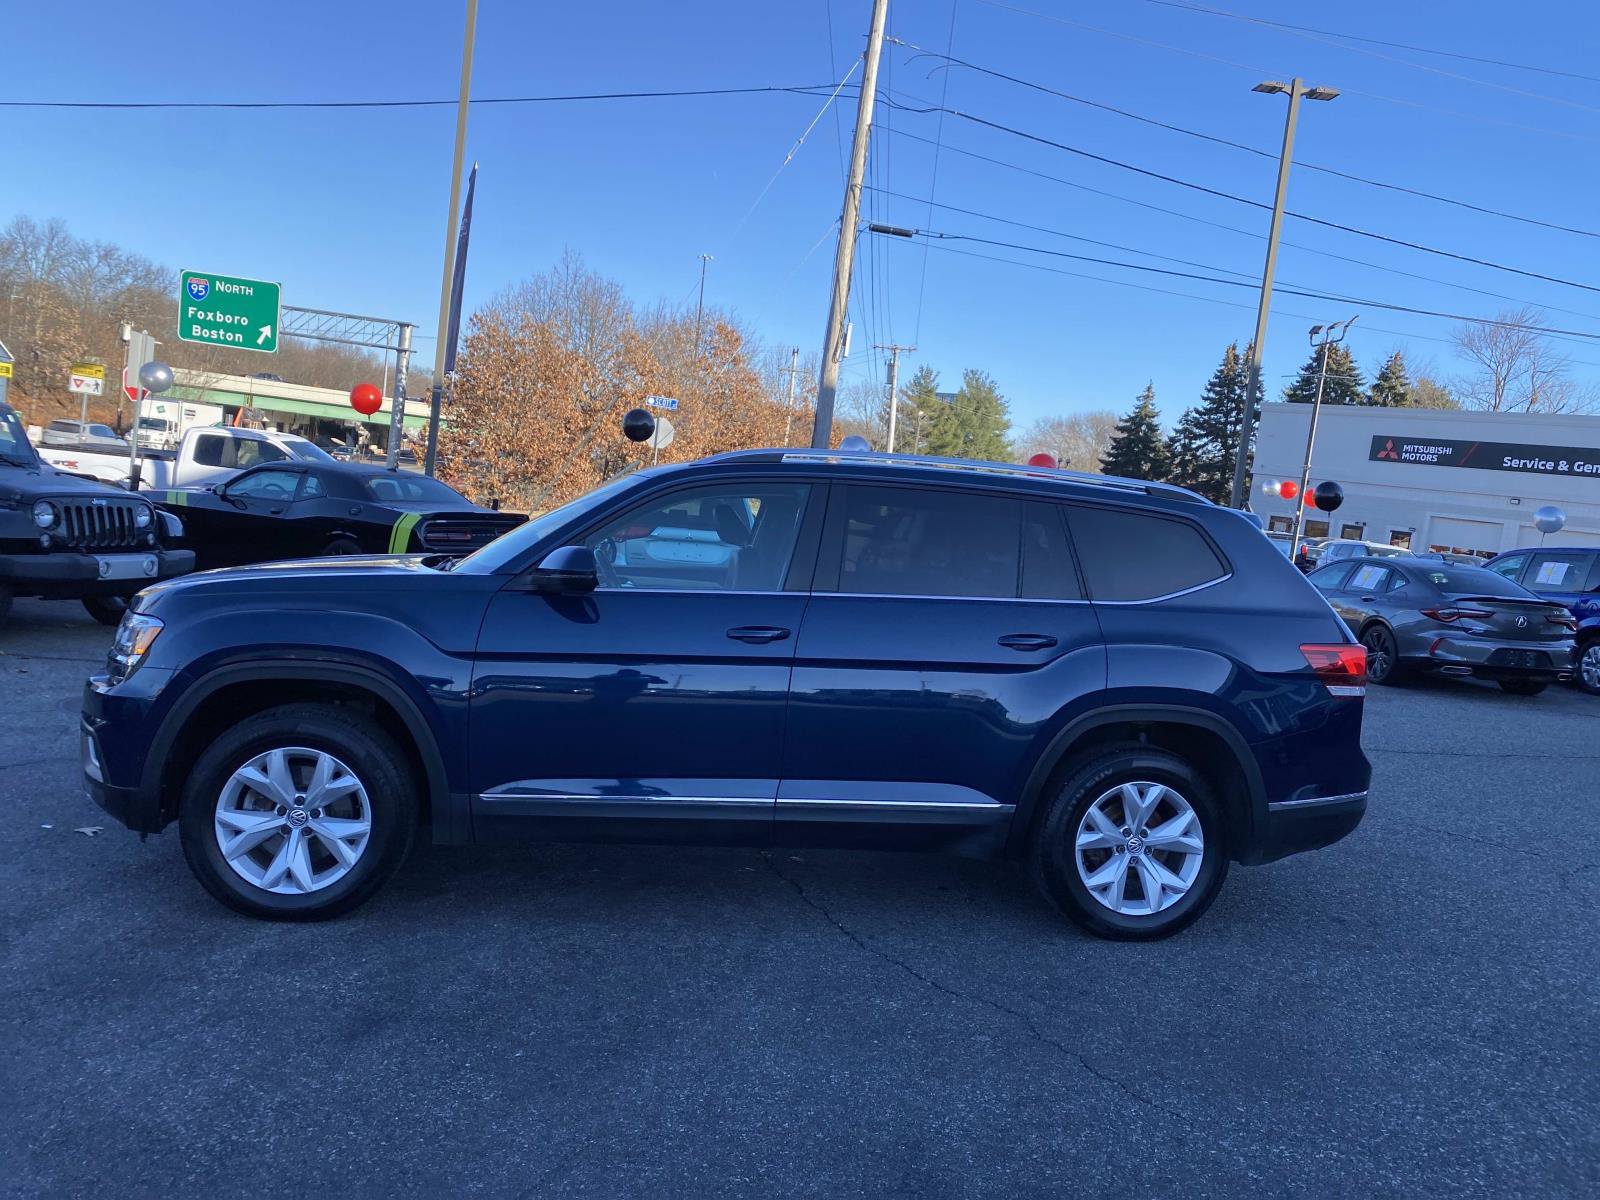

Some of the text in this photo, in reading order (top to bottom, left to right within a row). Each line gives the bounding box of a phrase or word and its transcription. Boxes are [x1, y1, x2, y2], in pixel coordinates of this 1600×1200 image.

[191, 285, 205, 296] 95
[215, 280, 253, 296] NORTH
[188, 307, 248, 325] Foxboro
[192, 325, 243, 342] Boston
[1401, 452, 1438, 461] MOTORS
[1403, 445, 1453, 455] MITSUBISHI
[1502, 456, 1600, 473] Service & Gen
